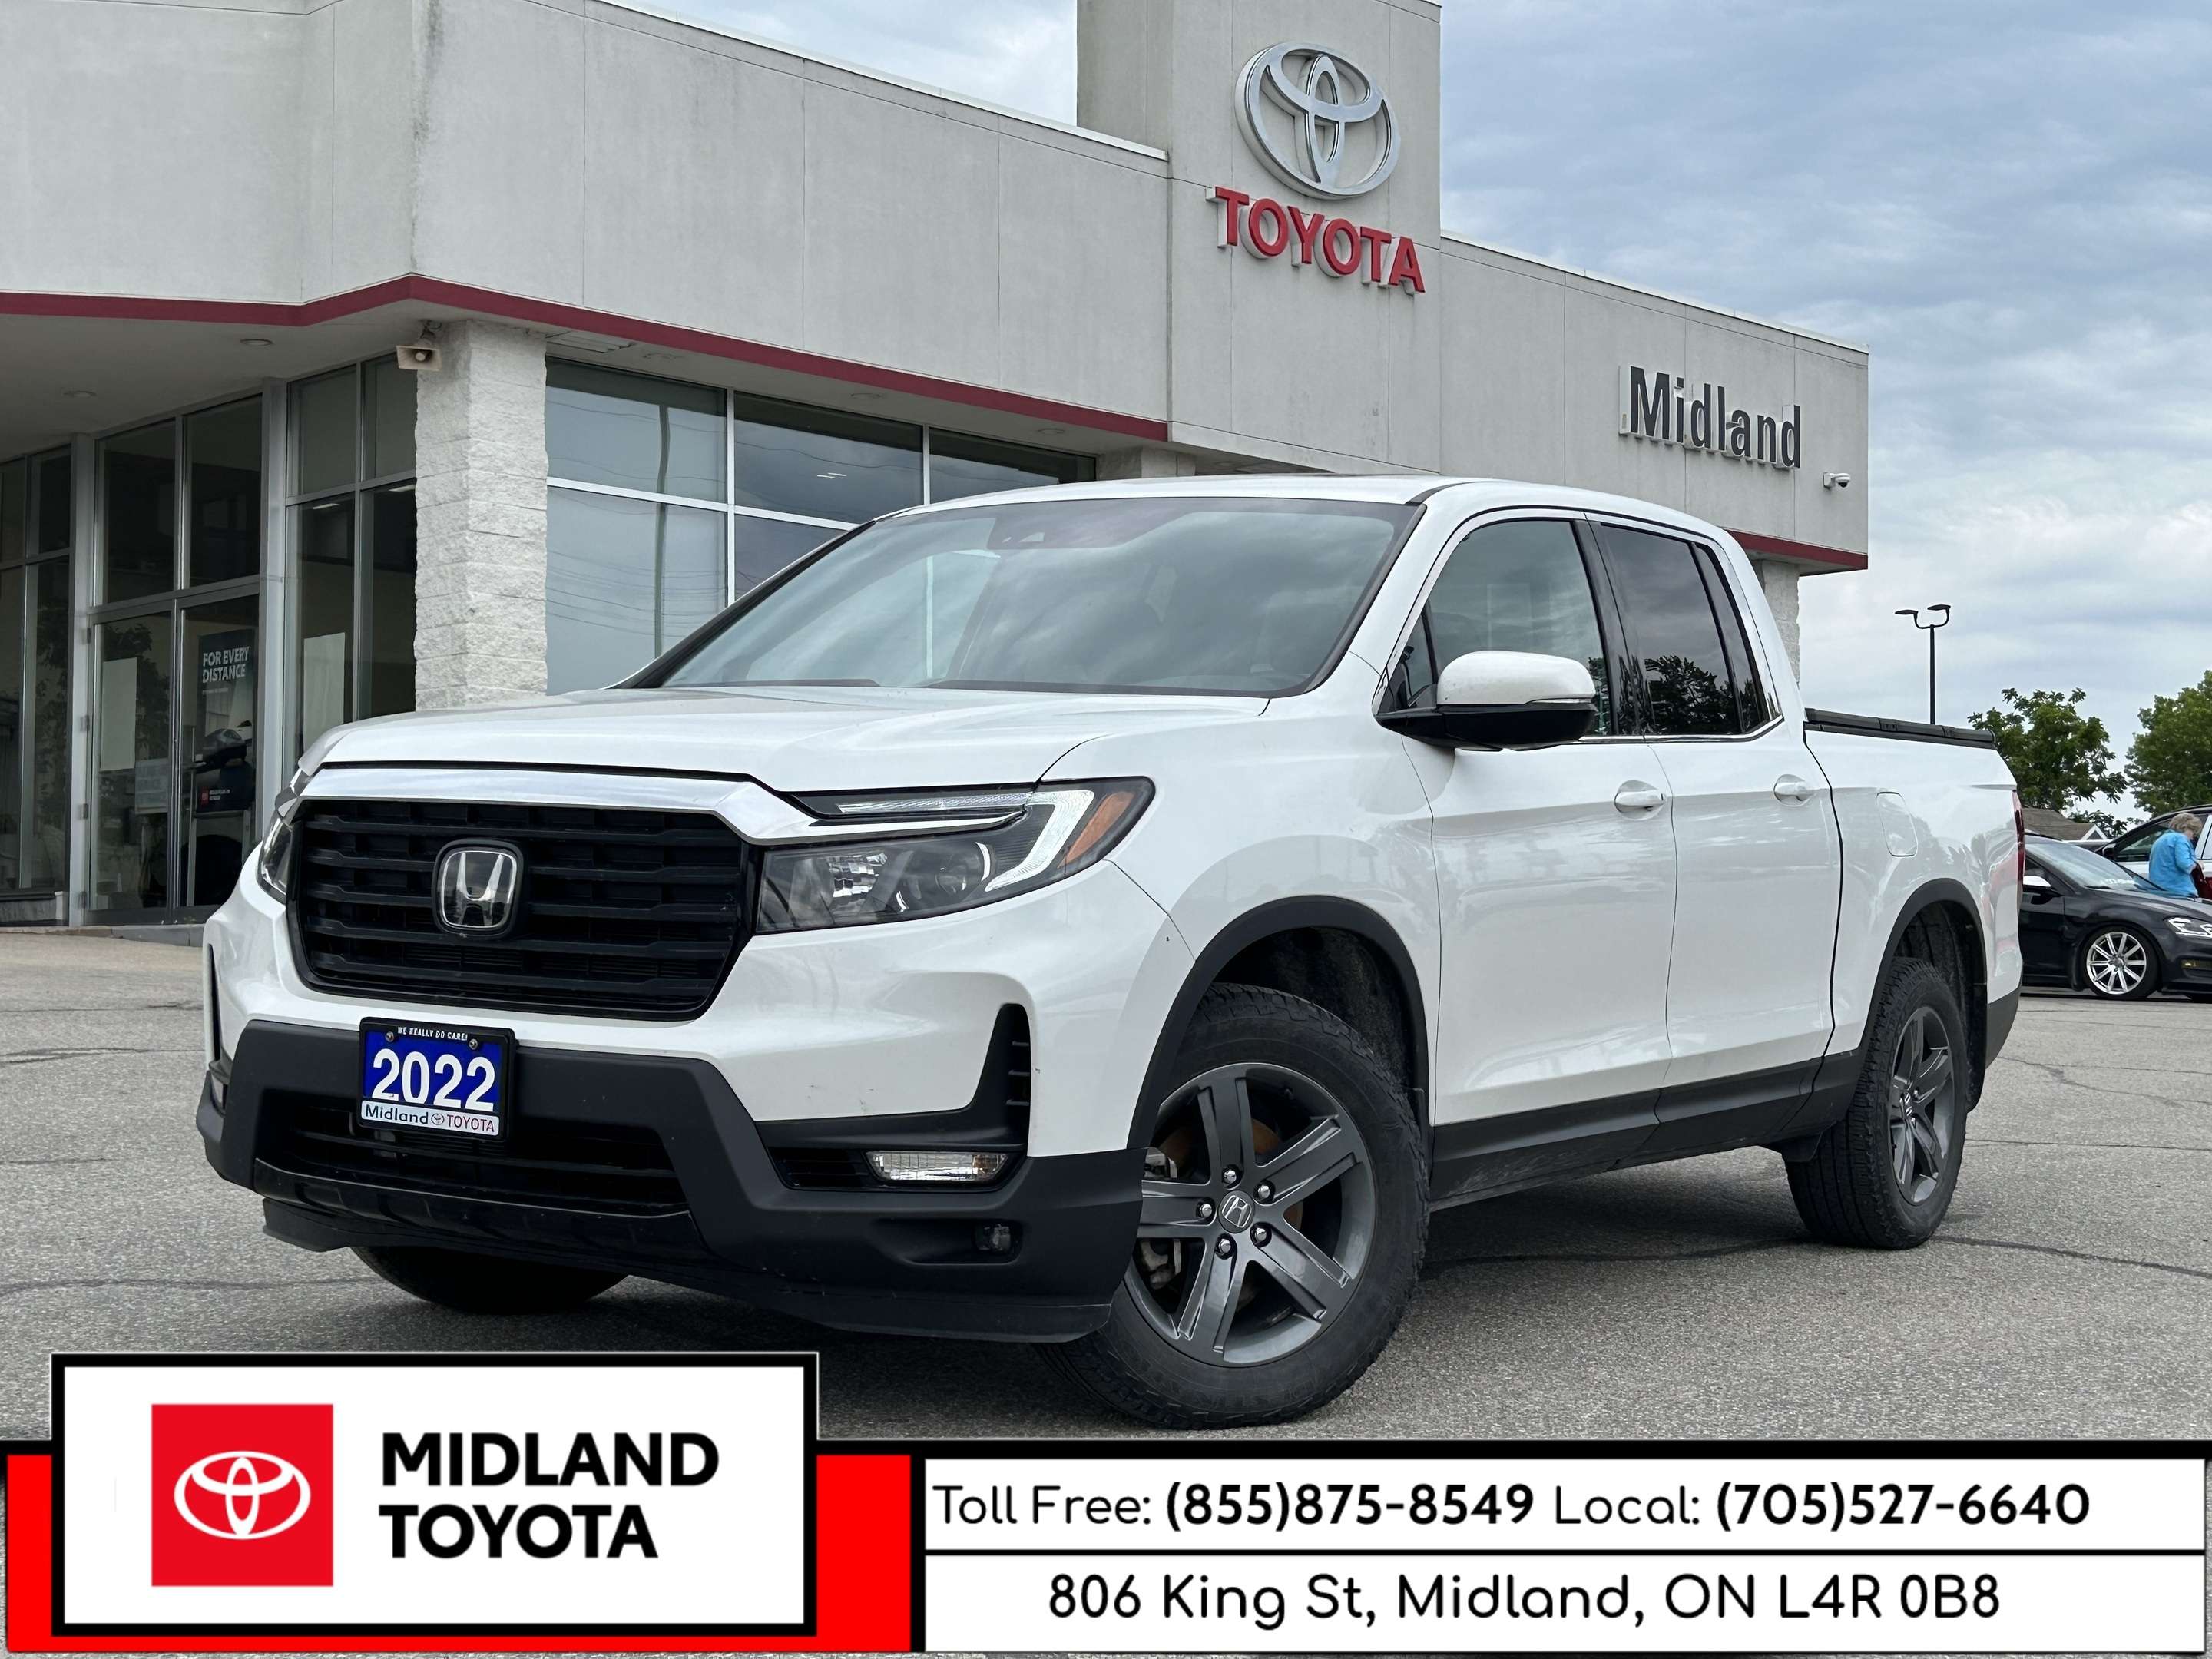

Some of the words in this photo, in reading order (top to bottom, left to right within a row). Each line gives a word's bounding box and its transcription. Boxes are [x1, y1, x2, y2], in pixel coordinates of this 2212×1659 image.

[1212, 186, 1426, 293] TOYOTA
[1628, 365, 1801, 468] Midland
[203, 651, 221, 667] FOR
[223, 646, 250, 664] EVERY
[202, 663, 246, 683] DISTANCE
[397, 1026, 407, 1035] WE
[409, 1028, 434, 1038] REALLY
[435, 1030, 445, 1039] DO
[371, 1048, 495, 1112] 2022
[365, 1104, 429, 1124] Midland
[447, 1114, 495, 1133] TOYOTA
